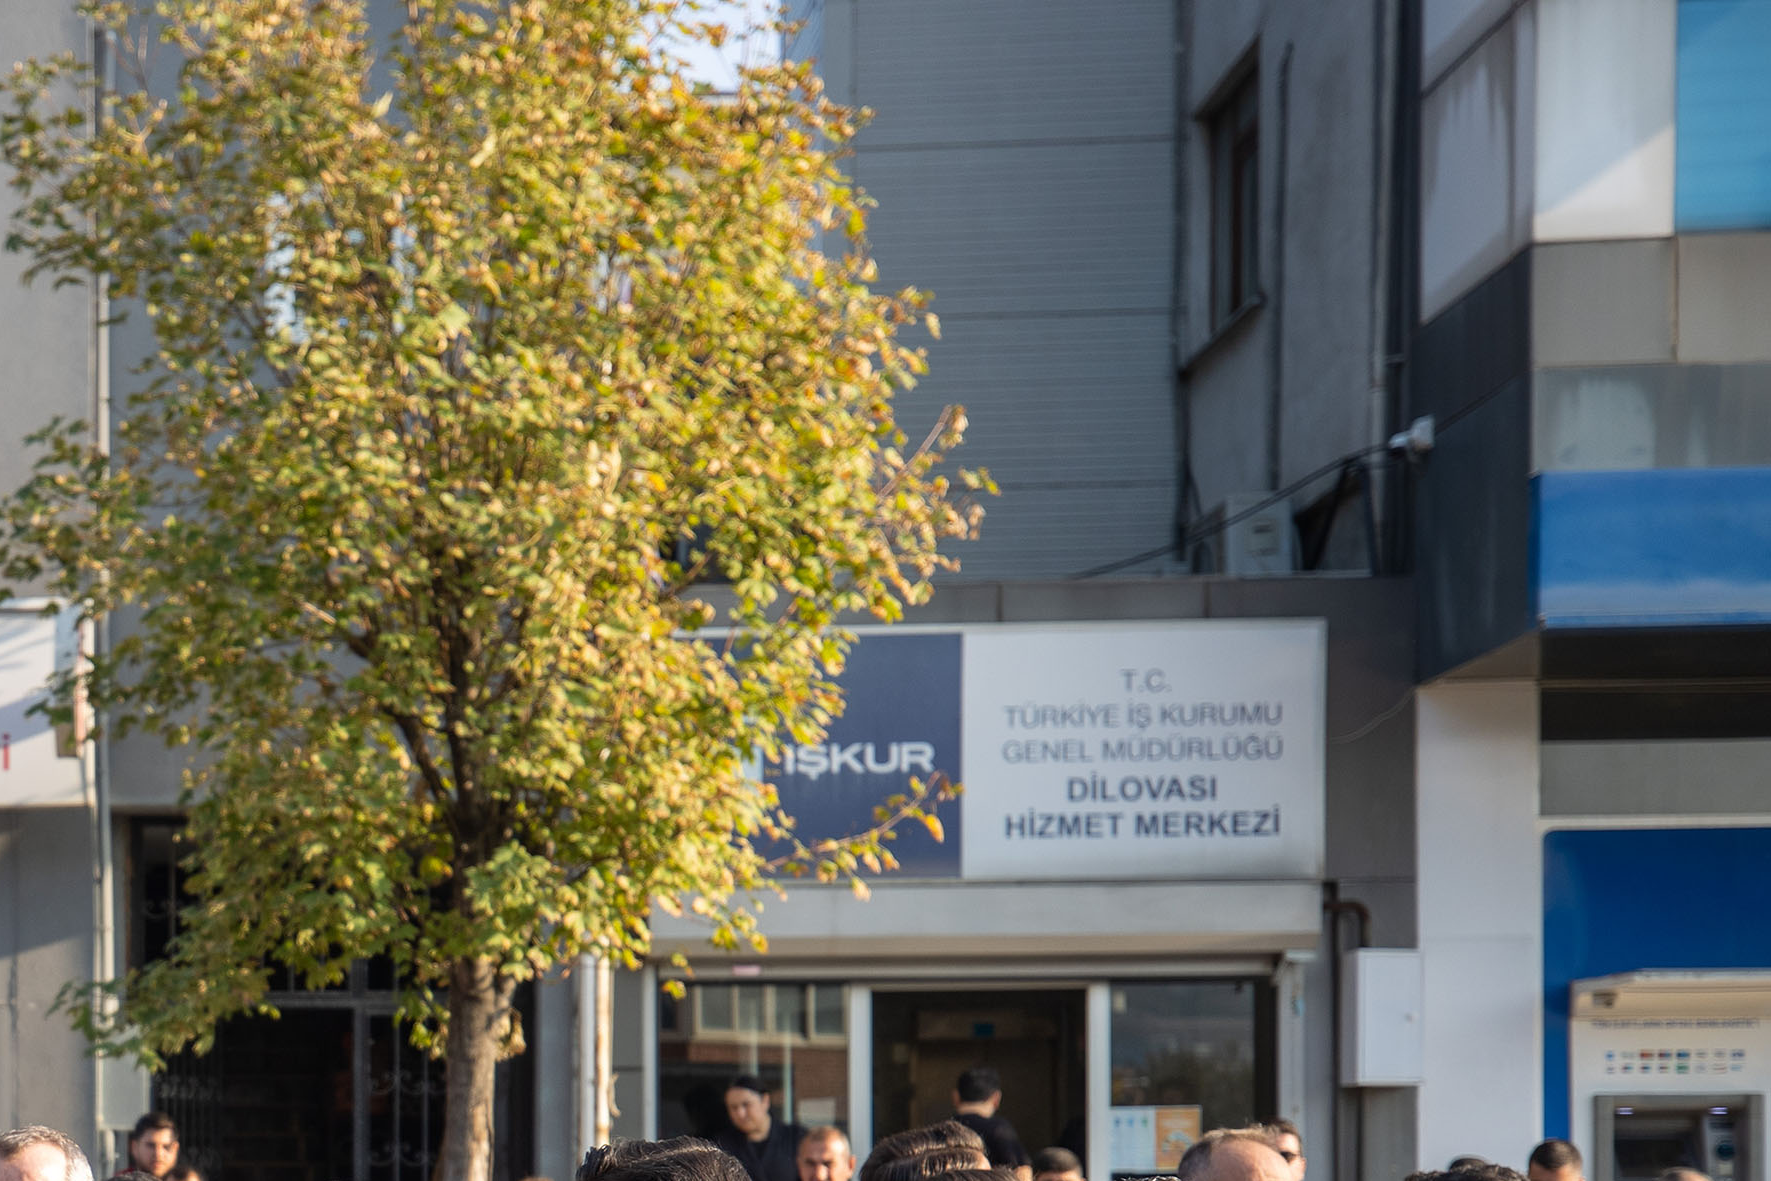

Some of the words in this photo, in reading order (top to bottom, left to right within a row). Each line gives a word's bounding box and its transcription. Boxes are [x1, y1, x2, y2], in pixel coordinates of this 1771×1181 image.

[1120, 668, 1172, 693] T.C.
[1003, 700, 1119, 729] TÜRKİYE
[1127, 699, 1152, 731] İŞ
[1160, 702, 1283, 727] KURUMU
[1002, 737, 1093, 764] GENEL
[1101, 732, 1284, 762] MÜDÜRLÜĞÜ
[1067, 772, 1218, 801] DİLOVASI
[1004, 808, 1124, 839] HİZMET
[1135, 804, 1281, 837] MERKEZİ
